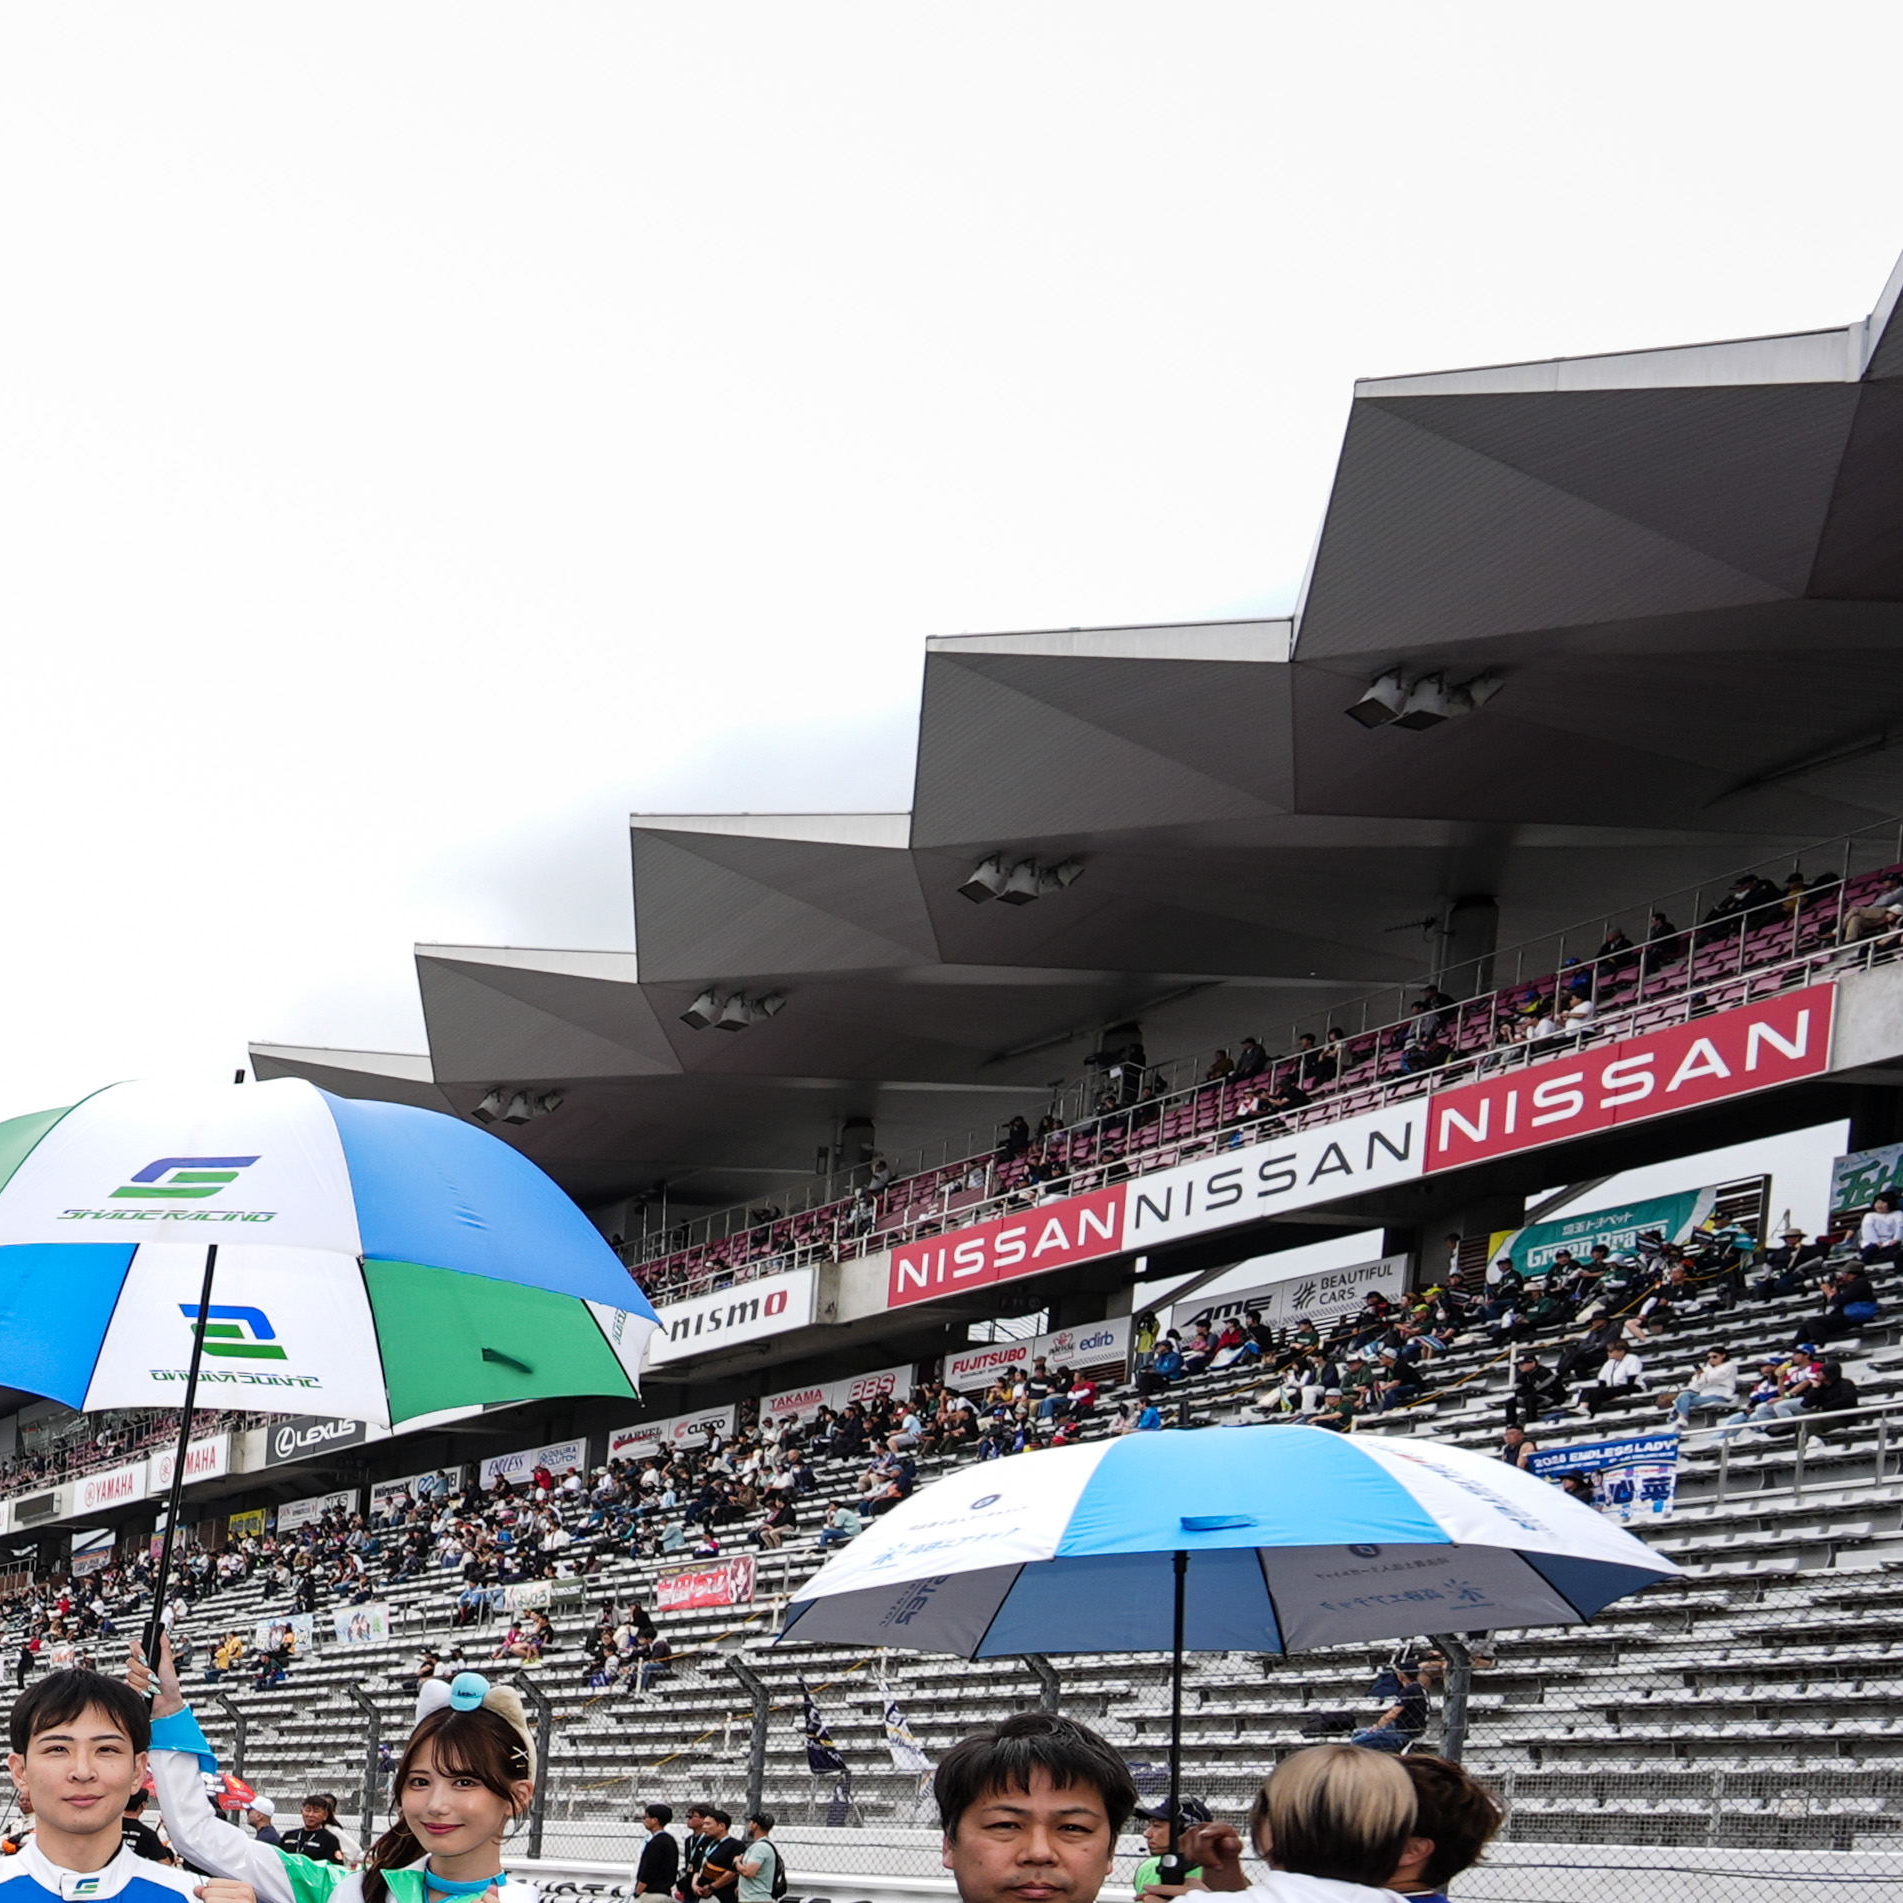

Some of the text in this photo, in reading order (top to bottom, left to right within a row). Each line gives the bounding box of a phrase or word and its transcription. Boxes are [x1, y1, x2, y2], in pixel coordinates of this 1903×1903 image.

[1439, 1009, 1811, 1152] NISSAN
[1135, 1121, 1413, 1229] NISSAN
[167, 1210, 278, 1223] RACING
[897, 1202, 1117, 1294] NISSAN
[1321, 1264, 1393, 1290] BEAUTIFUL
[1319, 1287, 1356, 1306] CARS
[671, 1290, 788, 1342] nismo
[1080, 1331, 1114, 1351] edirb
[952, 1346, 1027, 1375] FUJITSUBO
[849, 1374, 896, 1400] BBS
[294, 1419, 358, 1448] LEXUS
[96, 1473, 134, 1503] YAMAHA
